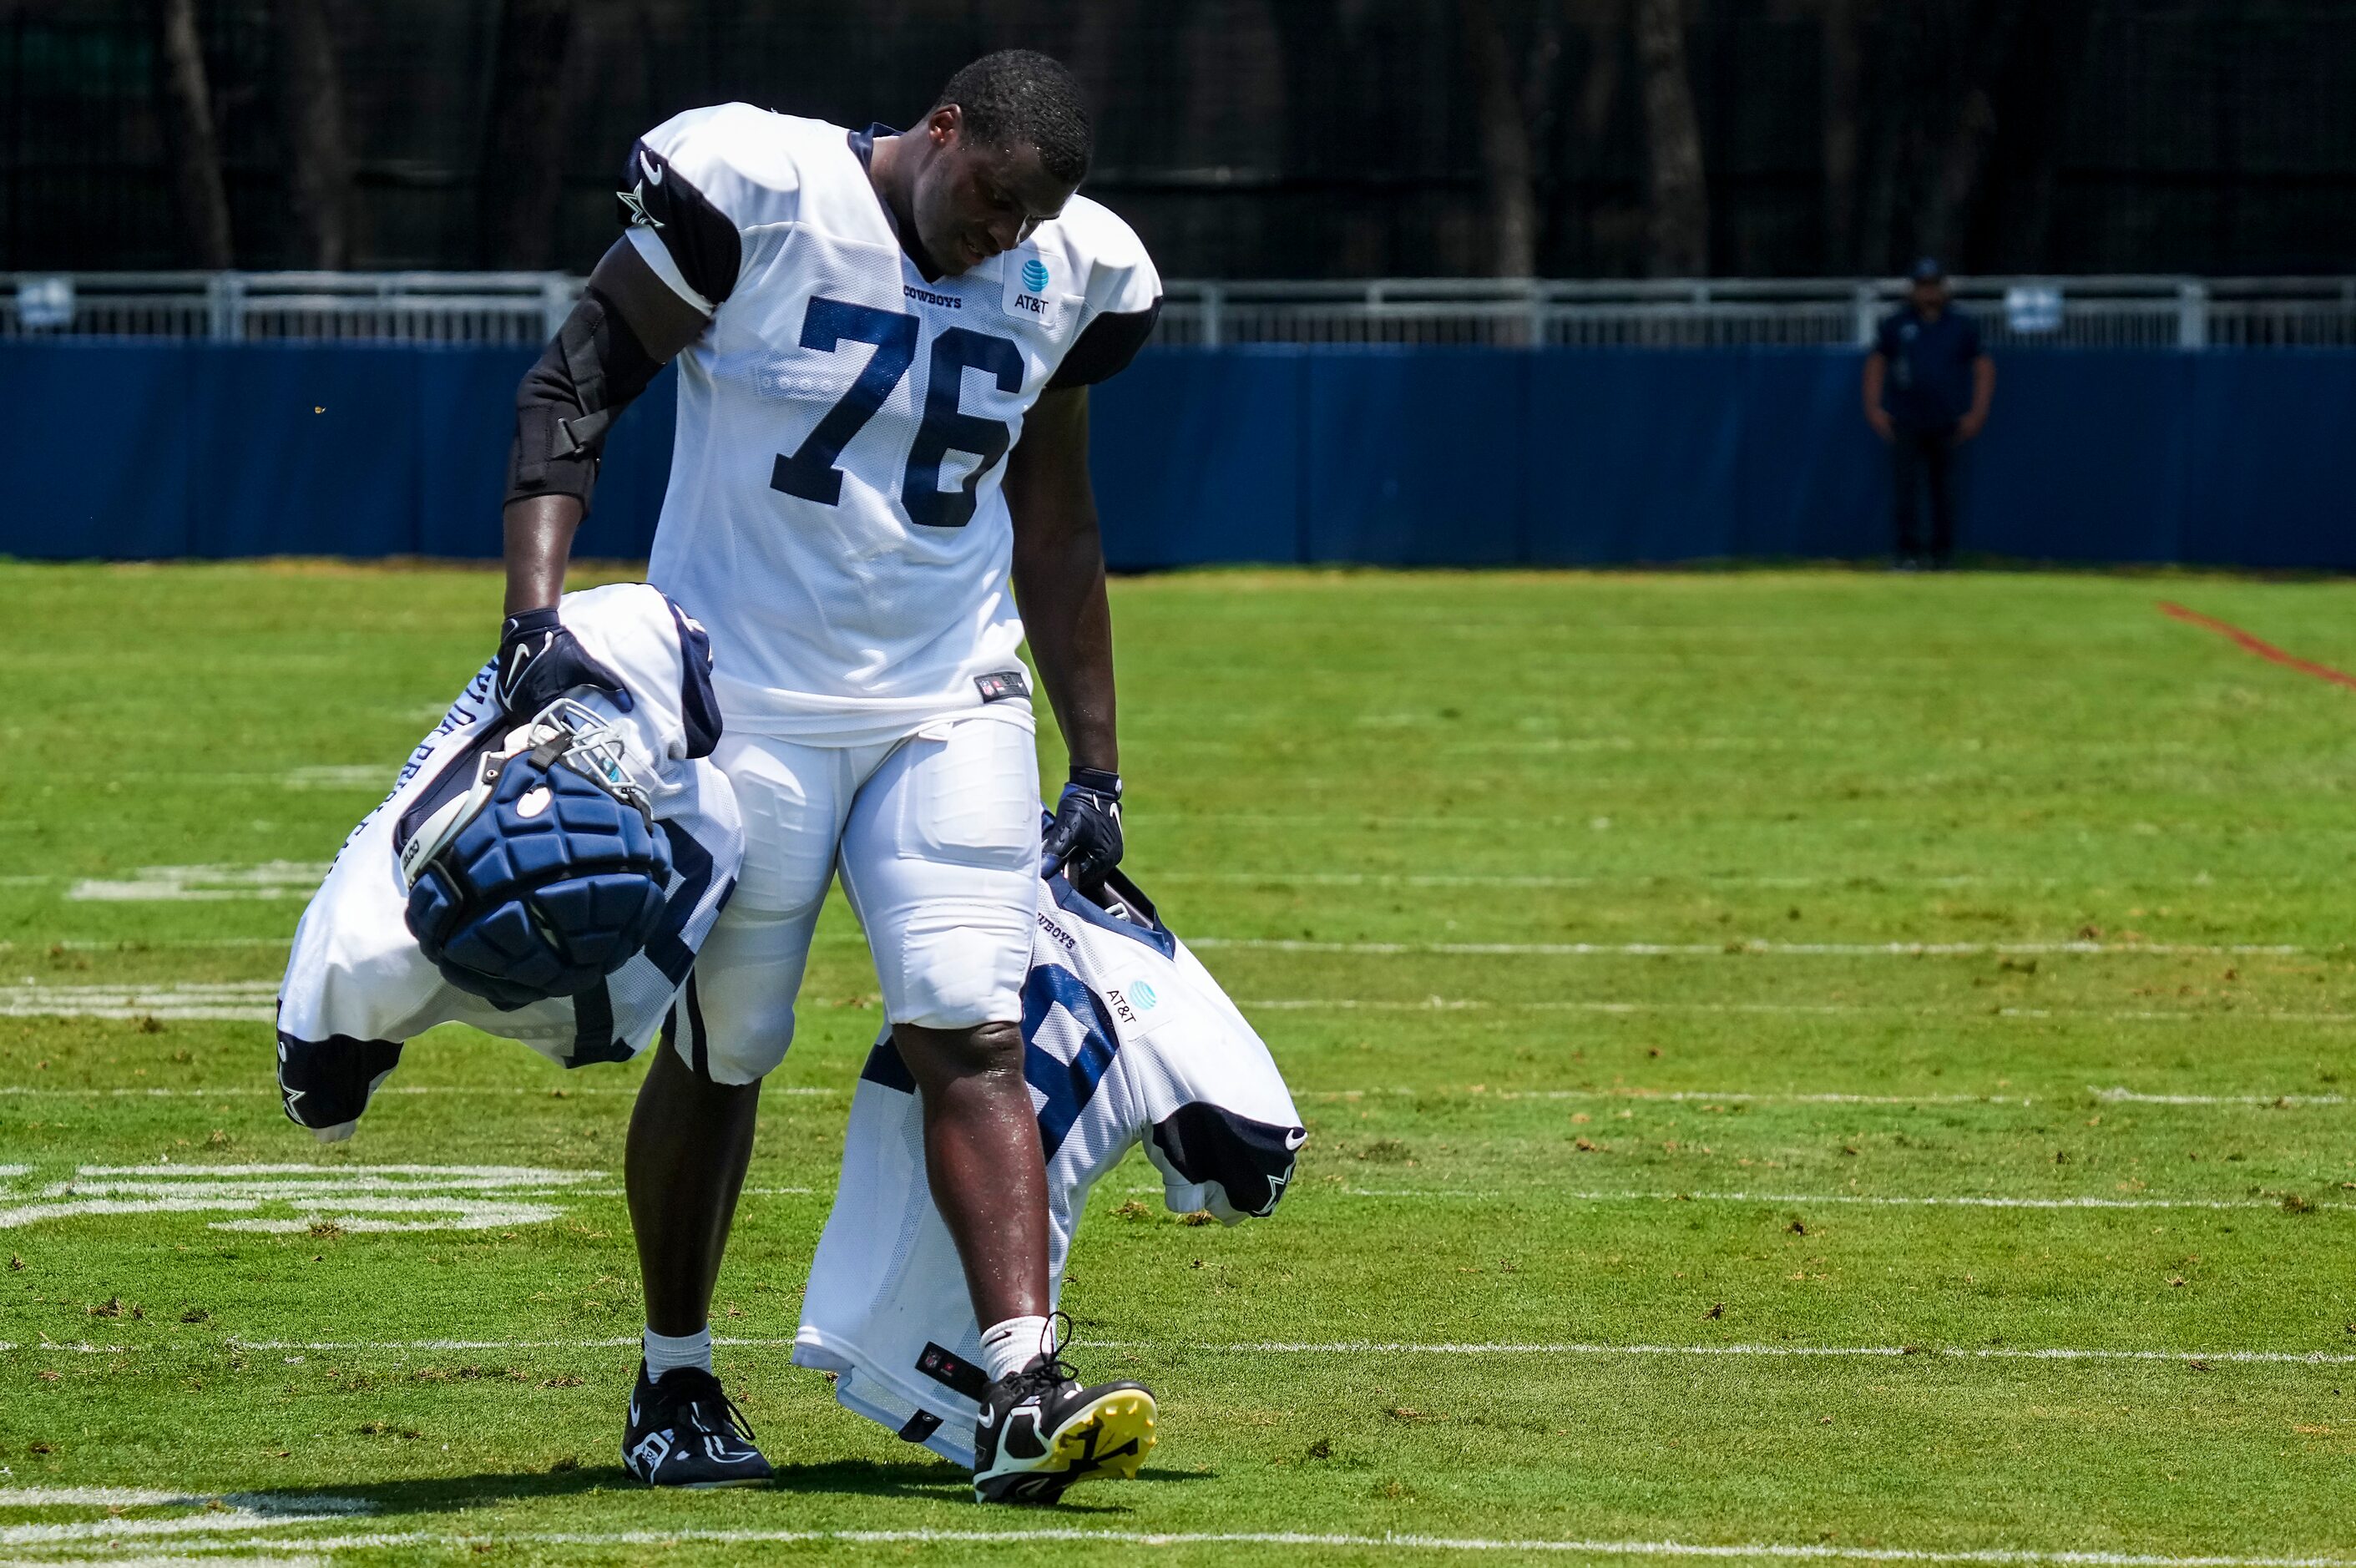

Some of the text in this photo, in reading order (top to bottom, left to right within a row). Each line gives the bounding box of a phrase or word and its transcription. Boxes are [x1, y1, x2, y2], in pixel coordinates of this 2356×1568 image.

[903, 285, 962, 309] COWBOYS
[1014, 294, 1049, 314] AT&T
[770, 295, 1024, 528] 76
[1106, 990, 1136, 1024] AT&T
